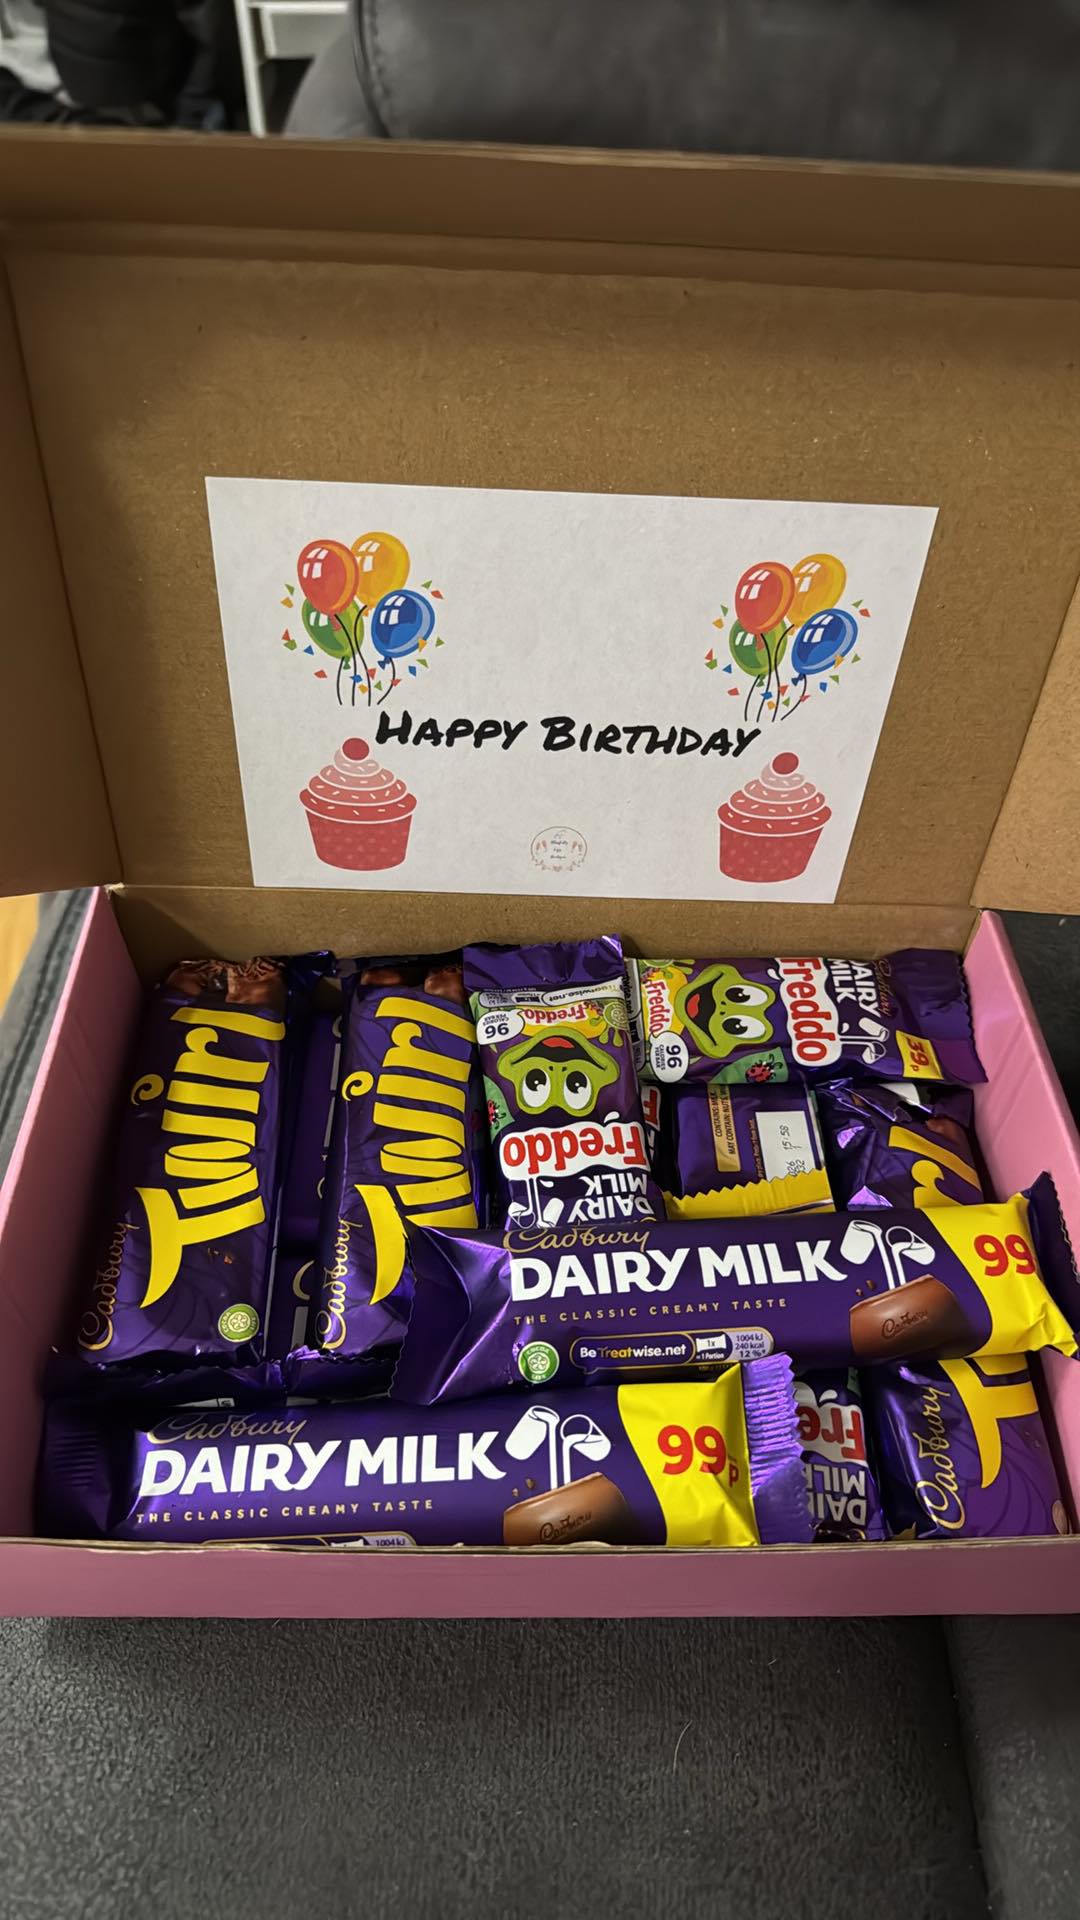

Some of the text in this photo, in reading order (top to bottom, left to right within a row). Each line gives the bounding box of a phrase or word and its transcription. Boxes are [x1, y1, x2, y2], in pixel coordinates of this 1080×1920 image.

[376, 710, 761, 758] HAPPY BIRTHDAY
[485, 1022, 509, 1038] 96
[521, 1001, 587, 1023] Freddo
[647, 980, 669, 1035] Freddo
[779, 957, 832, 1062] Freddo
[665, 1044, 683, 1069] 96
[903, 1036, 930, 1073] 39p
[131, 1006, 286, 1309] Twirl
[342, 996, 479, 1305] Twirl
[503, 1123, 648, 1175] Freddo
[578, 1173, 648, 1197] MILK
[567, 1197, 655, 1226] DAIRY
[502, 1225, 651, 1254] Cadbury
[78, 1211, 140, 1351] Cadbury
[316, 1215, 363, 1351] Cadbury
[511, 1240, 848, 1300] DAIRY MILK
[514, 1298, 788, 1326] THE CLASSIC CREAMY TASTE
[580, 1343, 687, 1358] Be Treatwise.net
[148, 1413, 308, 1445] Cadbury
[797, 1406, 866, 1461] Fre
[138, 1432, 506, 1497] DAIRY MILK
[657, 1424, 739, 1488] 99p
[915, 1386, 966, 1530] Cadbury
[137, 1499, 434, 1524] THE CLASSIC CREAMY TASTE
[808, 1492, 867, 1526] DAI
